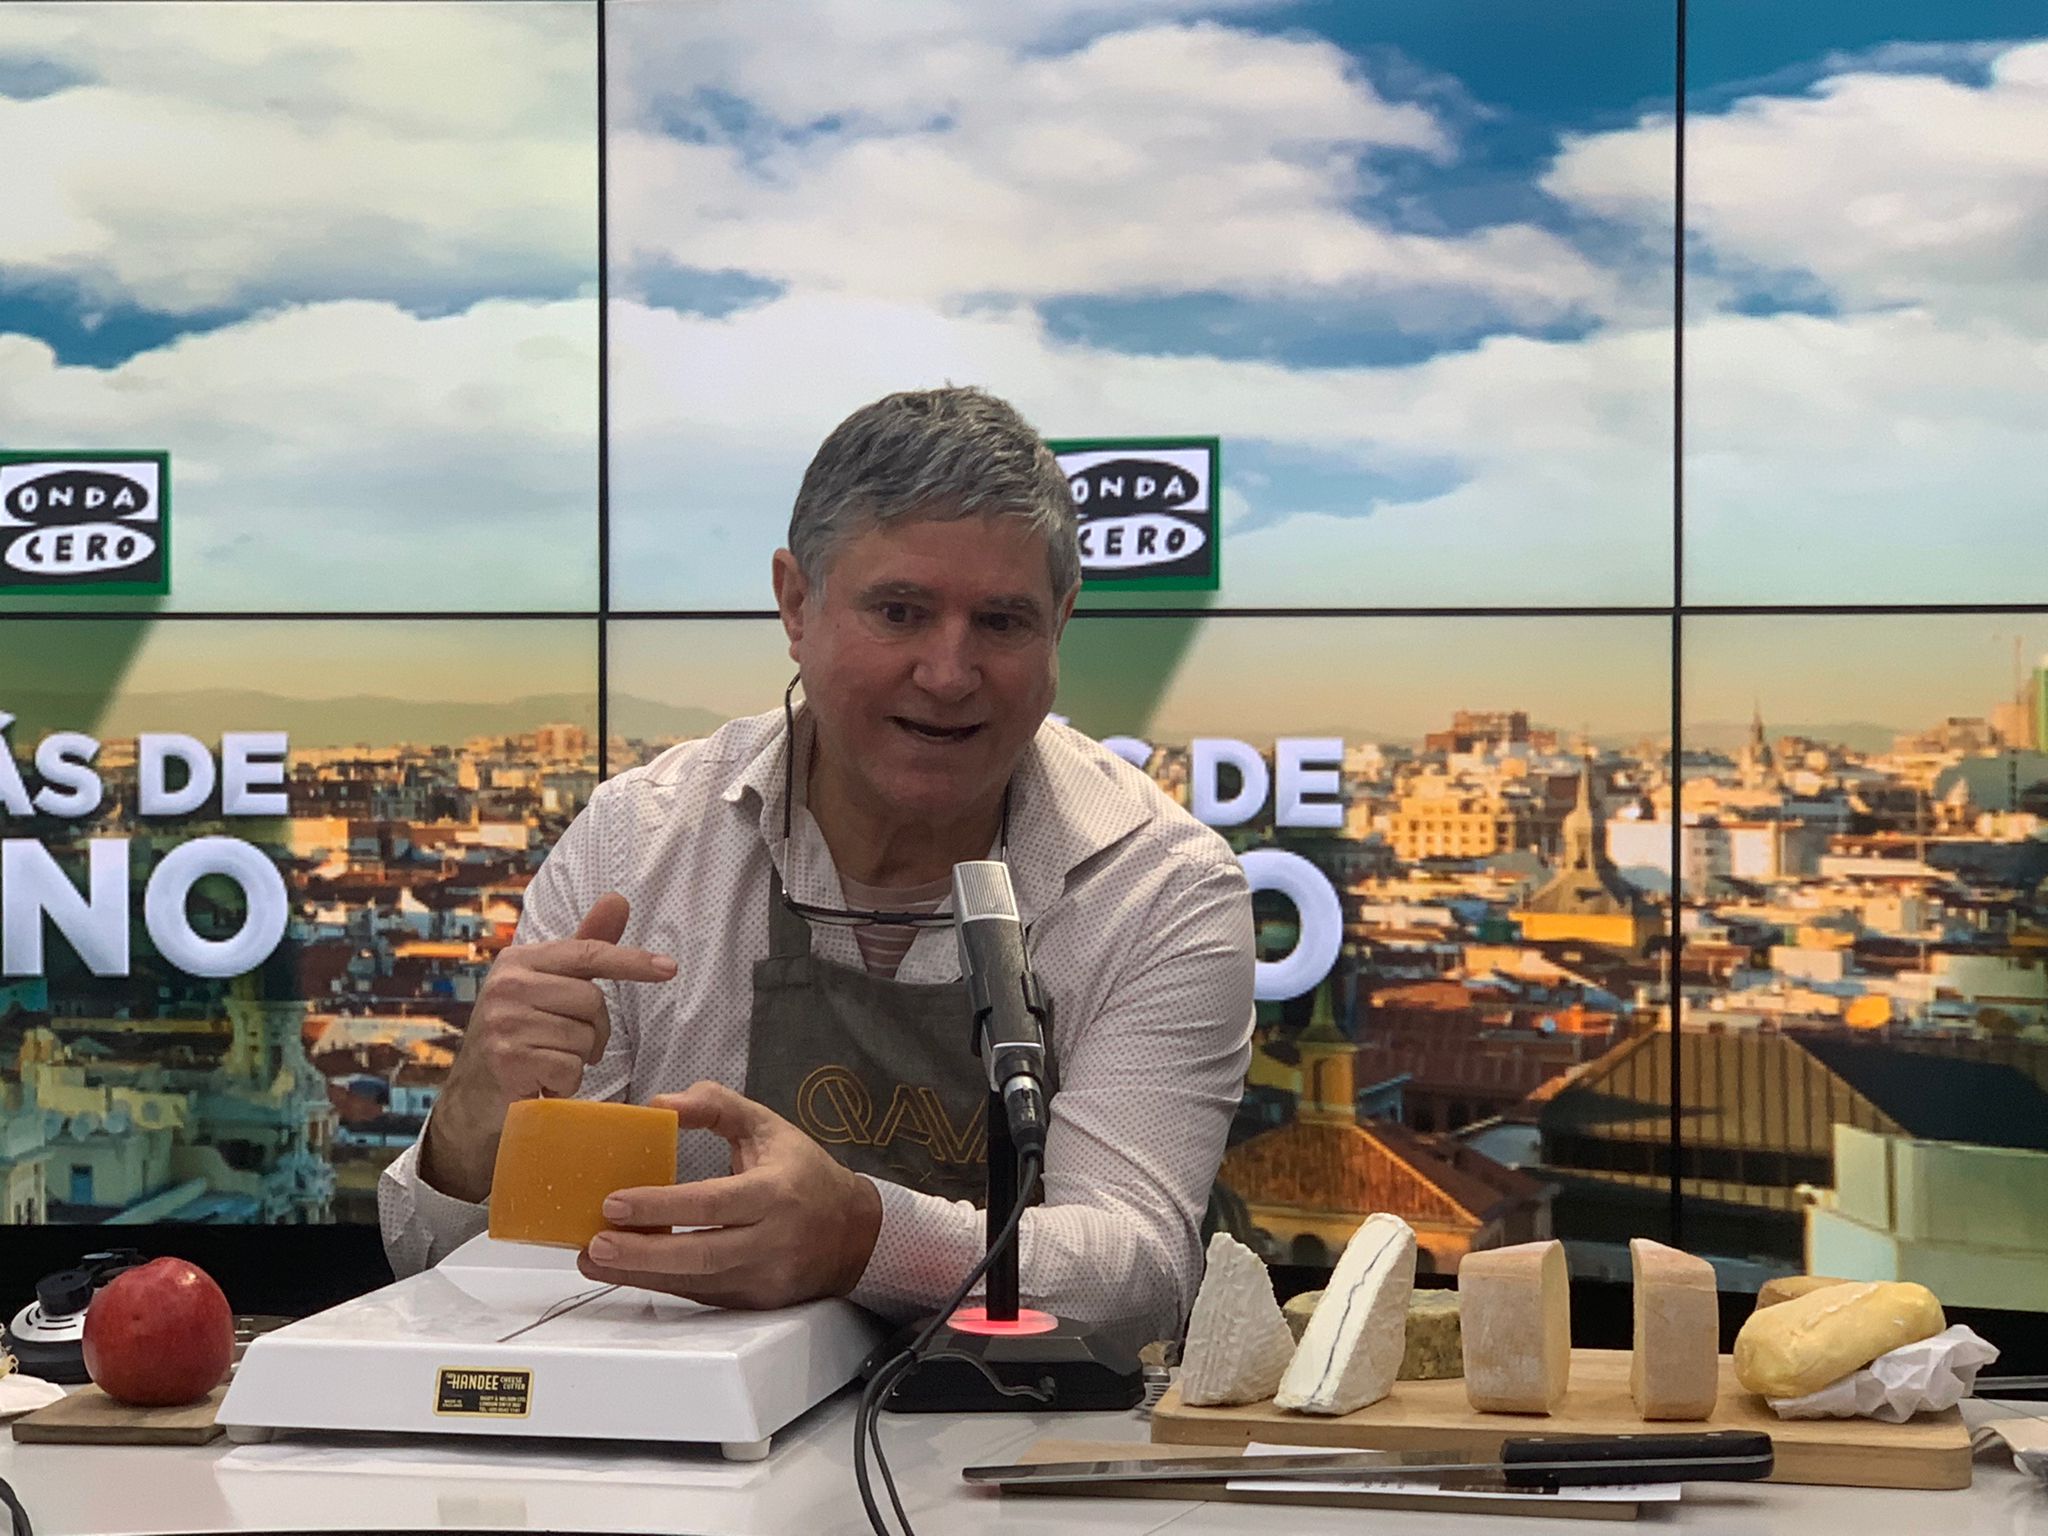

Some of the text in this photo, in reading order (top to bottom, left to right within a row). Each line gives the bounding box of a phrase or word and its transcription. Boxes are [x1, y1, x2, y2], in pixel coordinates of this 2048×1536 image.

[18, 486, 136, 513] ONDA
[1070, 476, 1187, 504] ONDA
[26, 533, 136, 564] CERO
[1079, 526, 1187, 558] CERO
[138, 731, 289, 816] DE
[1192, 738, 1344, 828] DE
[2, 835, 289, 979] NO
[797, 1065, 988, 1164] QAV
[448, 1374, 500, 1390] HANDEE
